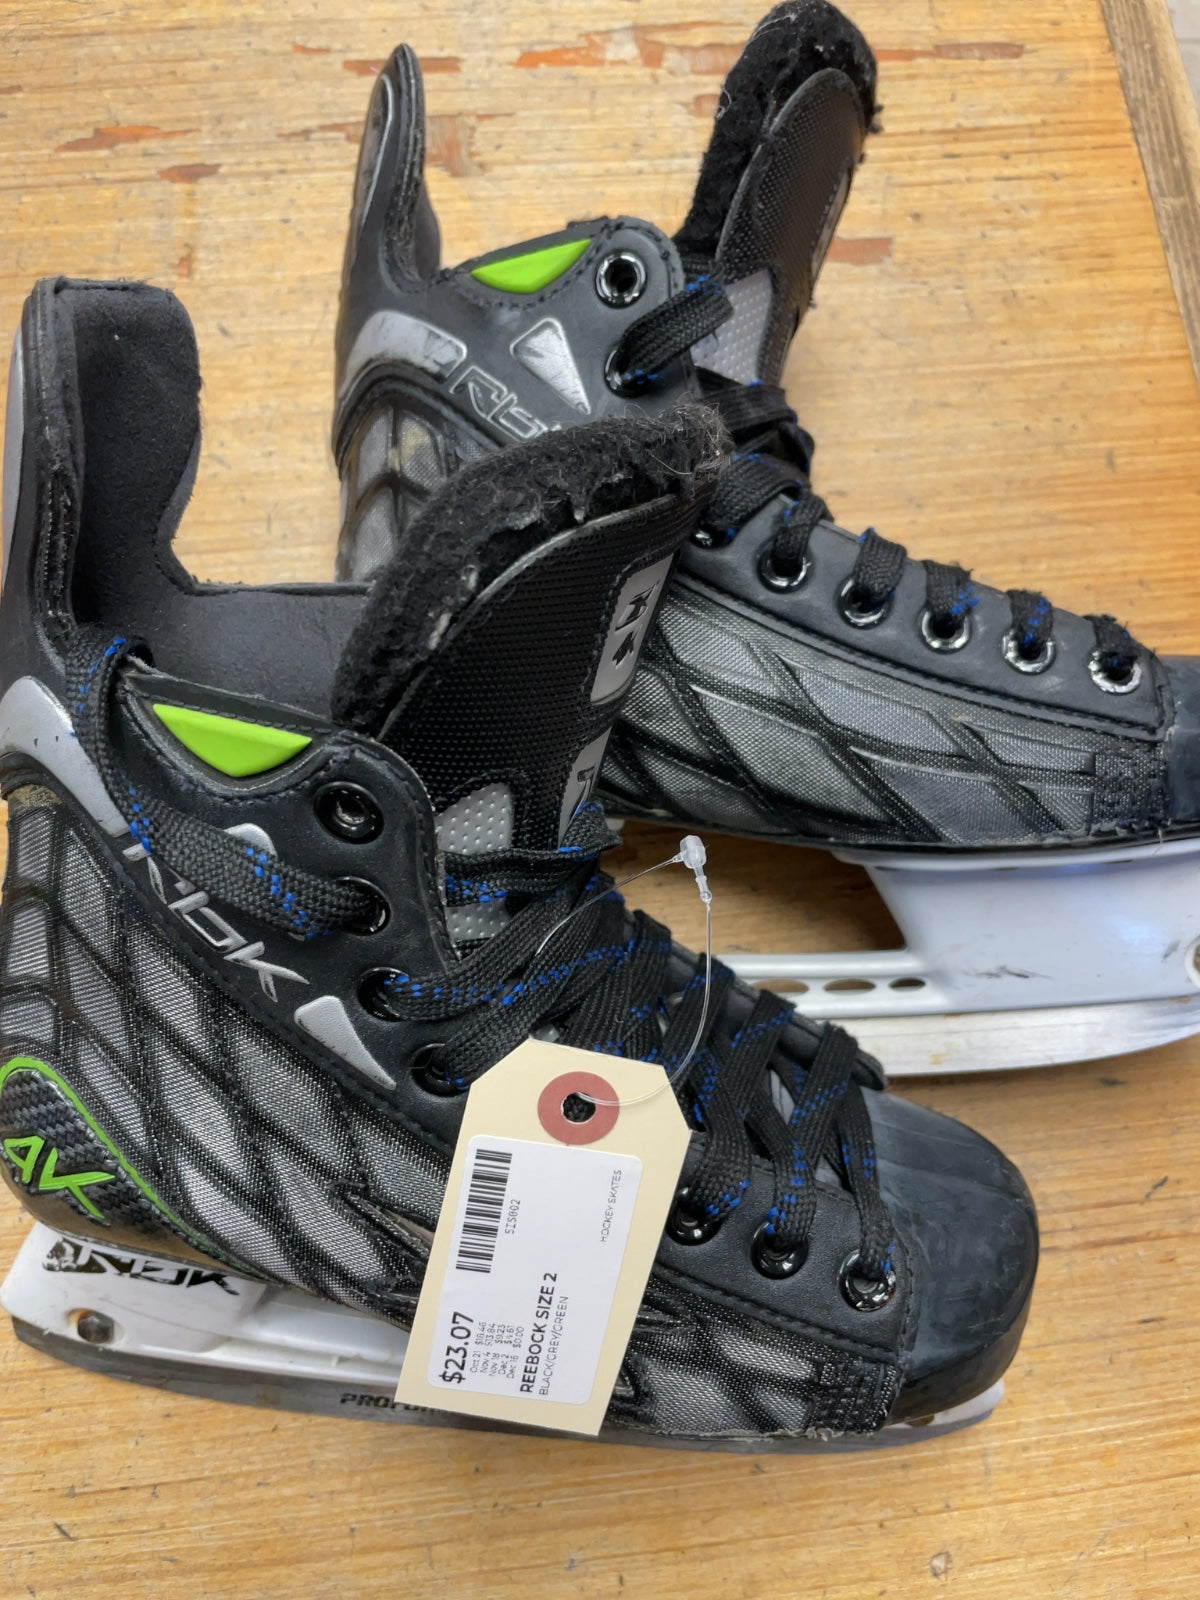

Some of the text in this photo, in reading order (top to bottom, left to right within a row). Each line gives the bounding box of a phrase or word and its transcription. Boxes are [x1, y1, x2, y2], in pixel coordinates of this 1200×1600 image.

[600, 1169, 622, 1242] HOCKEY SKATES
[520, 1272, 558, 1393] REEBOCK SIZE 2
[438, 1311, 474, 1384] $23.07
[538, 1295, 569, 1396] BLACK/GREY/GREEN
[470, 1359, 480, 1373] Oct
[480, 1359, 490, 1373] Nov
[489, 1362, 498, 1376] Nov
[498, 1360, 508, 1375] Dec
[506, 1364, 517, 1379] Dec
